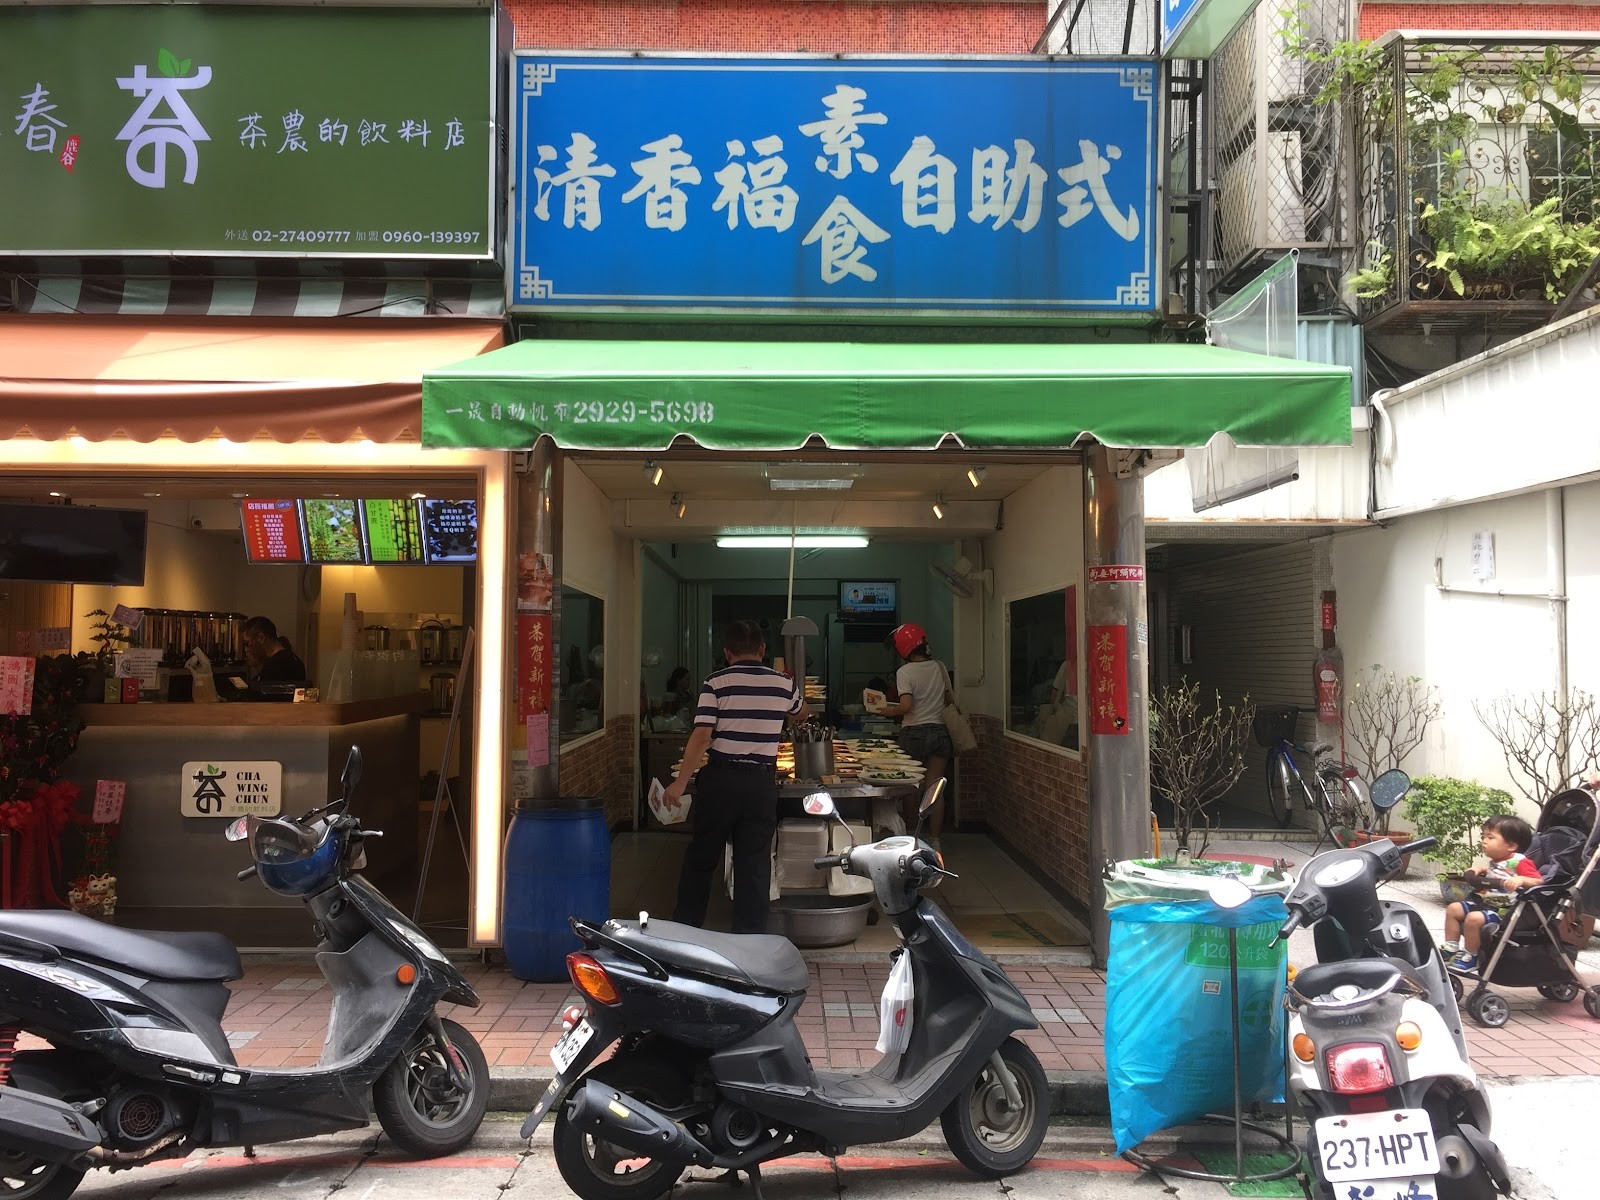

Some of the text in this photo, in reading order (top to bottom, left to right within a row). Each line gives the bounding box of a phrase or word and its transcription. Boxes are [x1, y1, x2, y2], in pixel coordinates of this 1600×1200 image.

[15, 82, 68, 153] 春
[238, 108, 467, 155] 茶農的飲料店
[224, 229, 480, 244] 外送 02-27409777 加盟 0960-139397
[573, 400, 715, 424] 2929-5698
[528, 622, 545, 710] 恭賀新禧
[1097, 632, 1117, 719] 恭賀新禧
[236, 772, 261, 781] CHA
[237, 783, 268, 793] WING
[235, 795, 269, 804] CHUN
